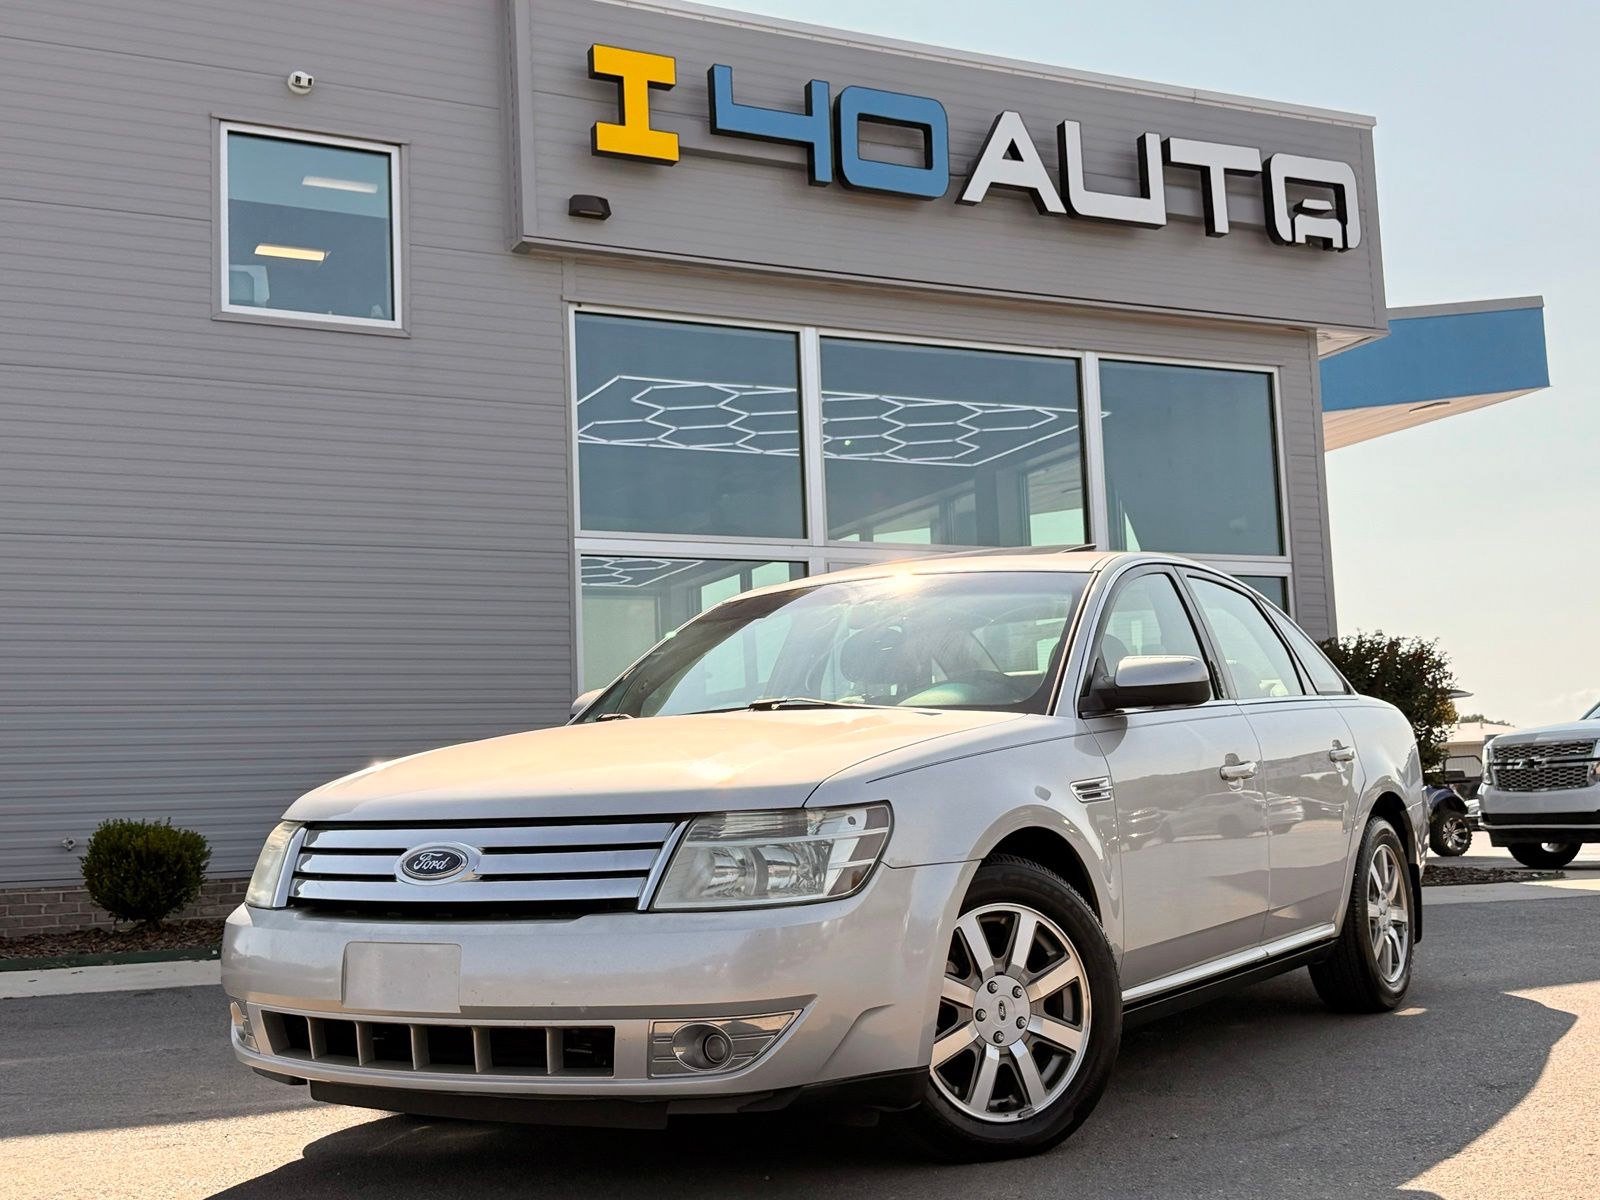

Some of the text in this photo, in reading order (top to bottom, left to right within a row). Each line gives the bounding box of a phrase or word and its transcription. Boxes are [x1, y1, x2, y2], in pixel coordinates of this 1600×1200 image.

[708, 63, 949, 199] 40
[957, 110, 1362, 250] AUTO
[413, 852, 450, 870] Ford
